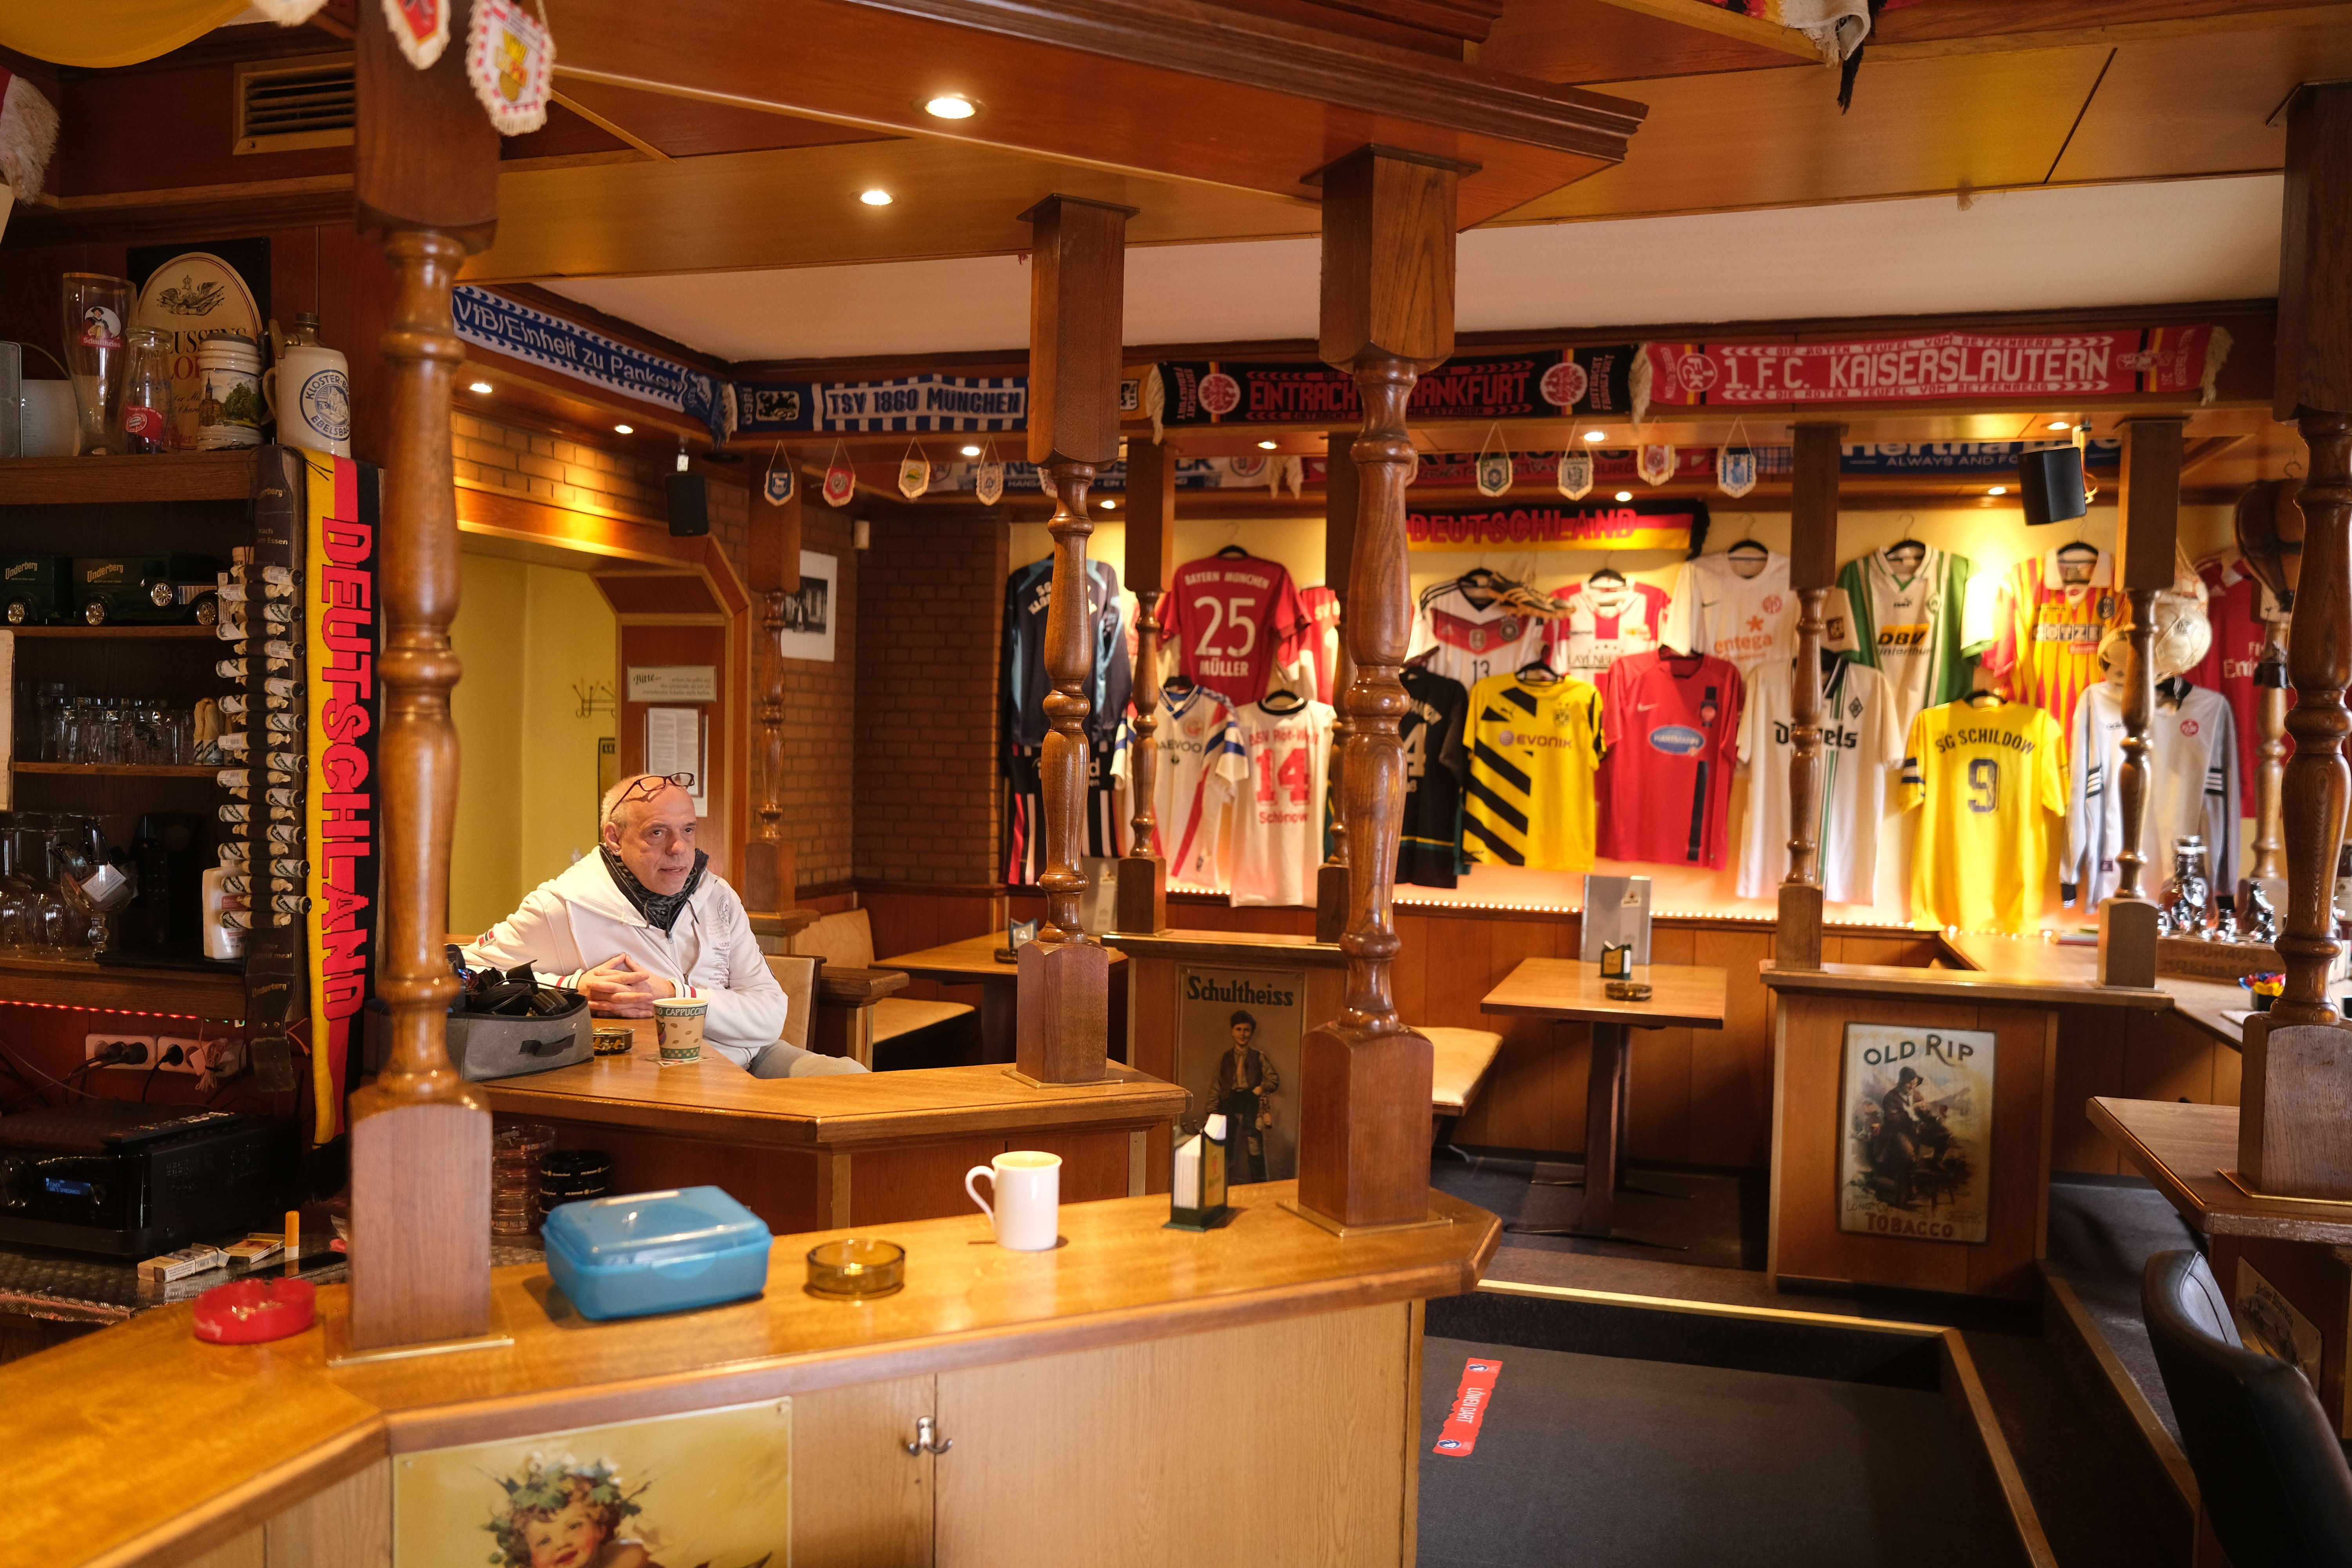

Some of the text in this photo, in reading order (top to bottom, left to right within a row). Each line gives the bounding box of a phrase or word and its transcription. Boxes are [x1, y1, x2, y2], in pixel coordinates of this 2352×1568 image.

[83, 337, 121, 348] Schultheiss
[454, 294, 683, 392] VfB/Einheit zu Pankow
[1829, 345, 2110, 388] KAISERSLAUTERN
[829, 393, 867, 415] TSV
[873, 388, 920, 413] 1860
[1250, 380, 1359, 411] EINTRACH
[1886, 457, 1953, 467] ALWAYS
[1958, 456, 1993, 466] AND
[1412, 508, 1638, 543] DEUTSCHLAND
[5, 561, 38, 580] Underberg
[87, 564, 124, 583] Underberg
[1184, 570, 1220, 586] BAYERN
[1194, 596, 1256, 658] 25
[1878, 631, 1927, 645] DBV
[1714, 634, 1773, 653] entega
[1200, 657, 1249, 677] MÜLLER
[1157, 739, 1202, 757] AEWOO
[1516, 731, 1573, 748] EVONIK
[1936, 727, 2035, 755] SG SCHILDOW
[322, 516, 372, 1021] DEUTSCHLAND
[1256, 748, 1311, 806] 14
[1967, 757, 2000, 816] 9
[252, 983, 287, 998] Underberg
[1187, 975, 1294, 1007] Schultheiss
[1864, 1034, 1975, 1068] OLD RIP
[1865, 1212, 1955, 1238] TOBACCO
[1460, 1387, 1484, 1407] LÖWEN
[1455, 1406, 1477, 1424] DART
